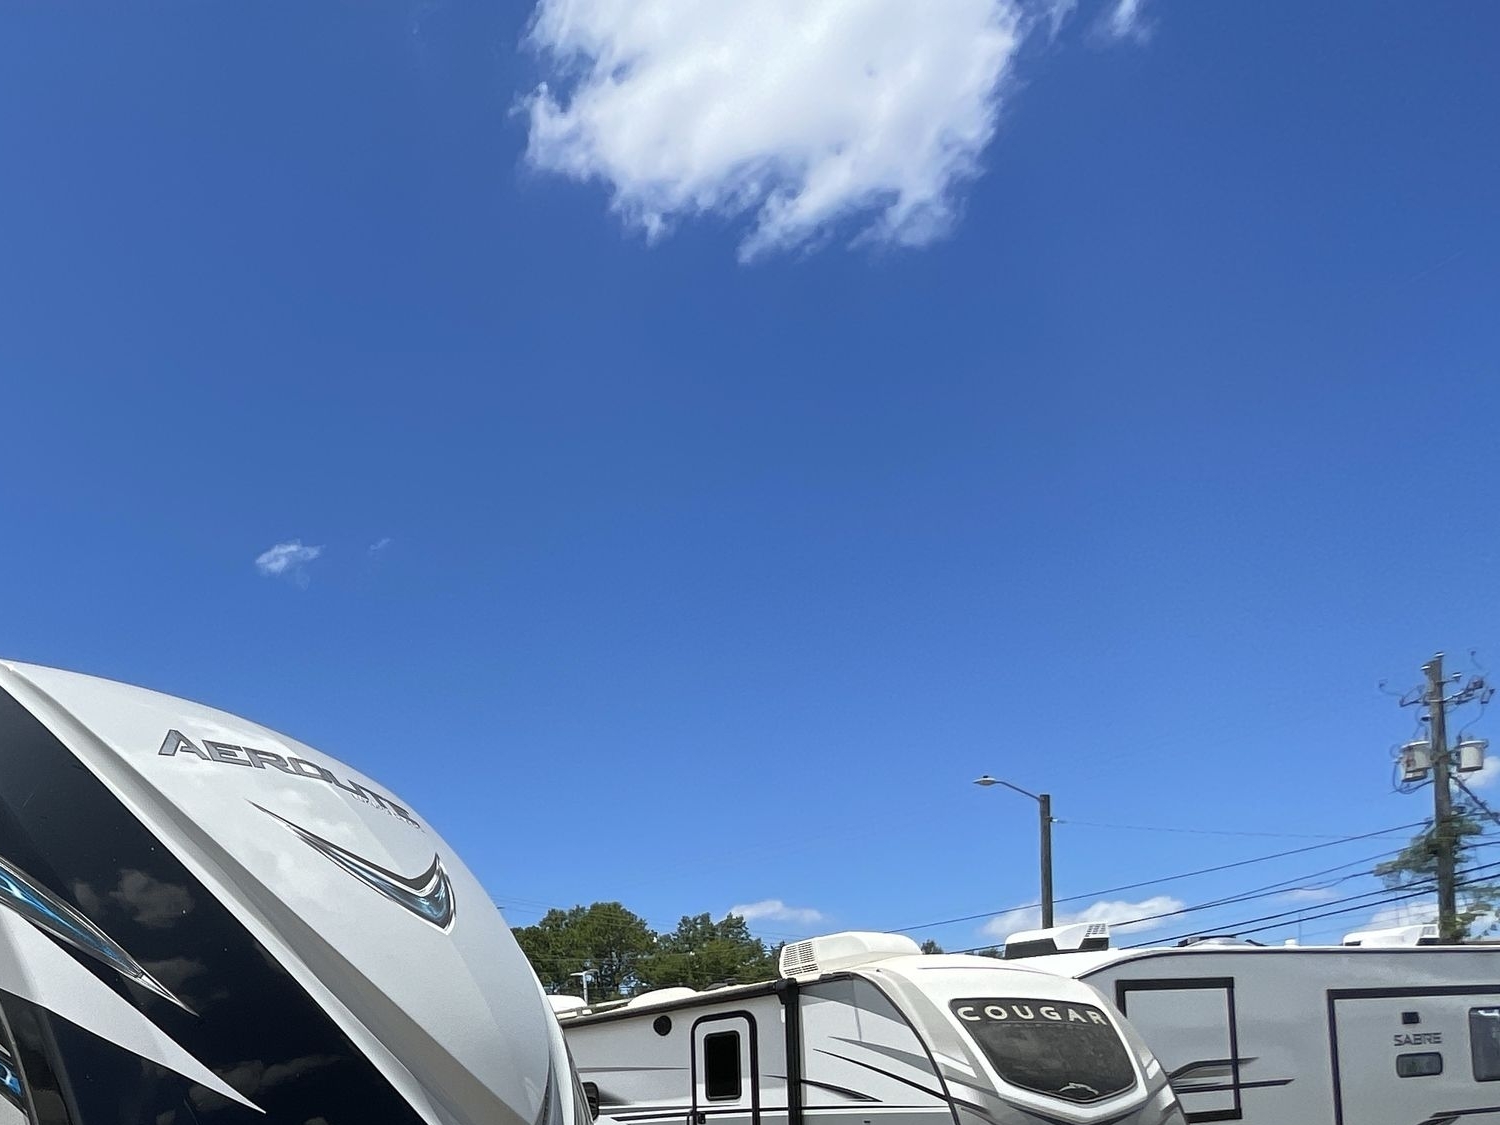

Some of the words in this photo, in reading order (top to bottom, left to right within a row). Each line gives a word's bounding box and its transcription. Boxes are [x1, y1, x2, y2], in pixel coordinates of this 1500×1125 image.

[158, 729, 422, 829] AEROLITE
[957, 1005, 1108, 1026] COUGAR
[1393, 1032, 1443, 1047] SABRE
